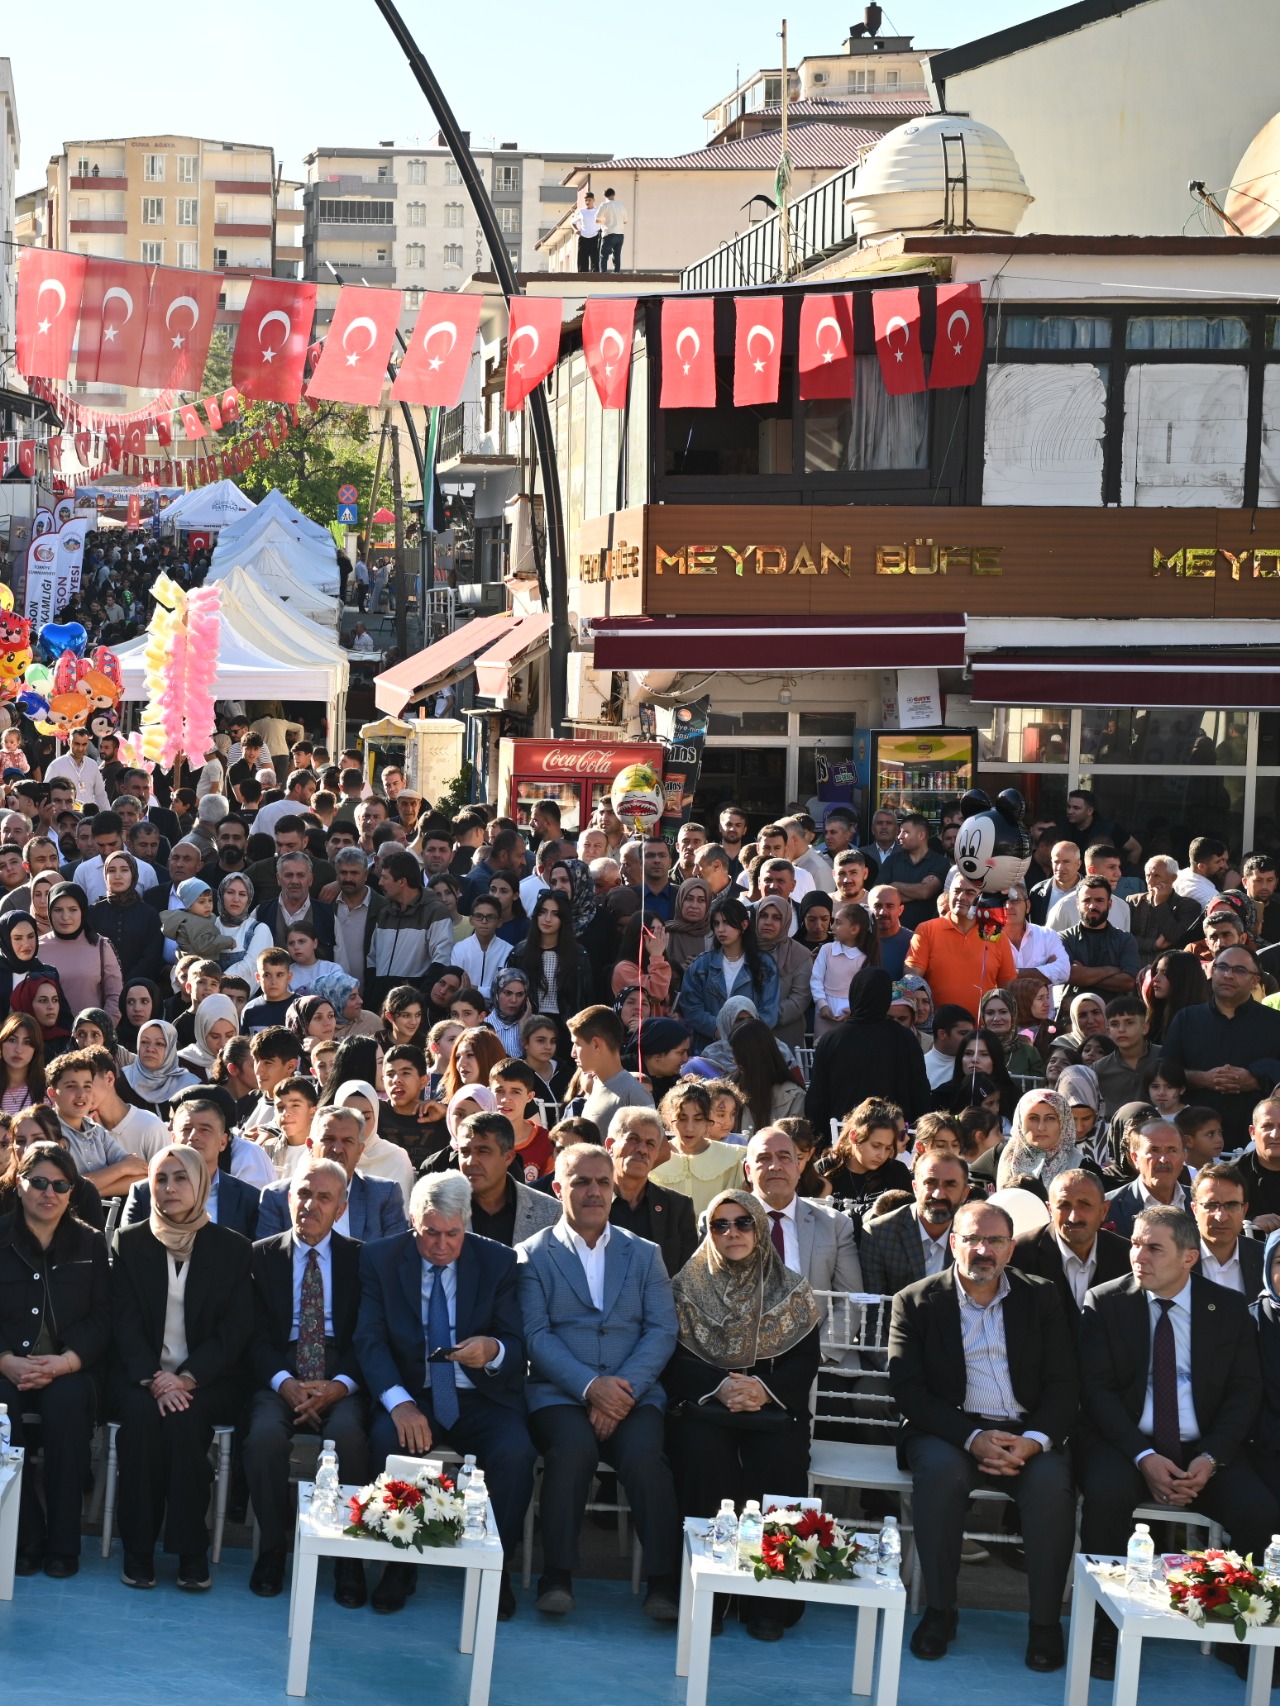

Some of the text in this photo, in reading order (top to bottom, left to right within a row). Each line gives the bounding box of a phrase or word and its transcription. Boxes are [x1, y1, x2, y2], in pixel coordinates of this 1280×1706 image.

[656, 538, 1005, 578] MEYDAN BÜFE
[542, 748, 616, 774] Coca-Cola
